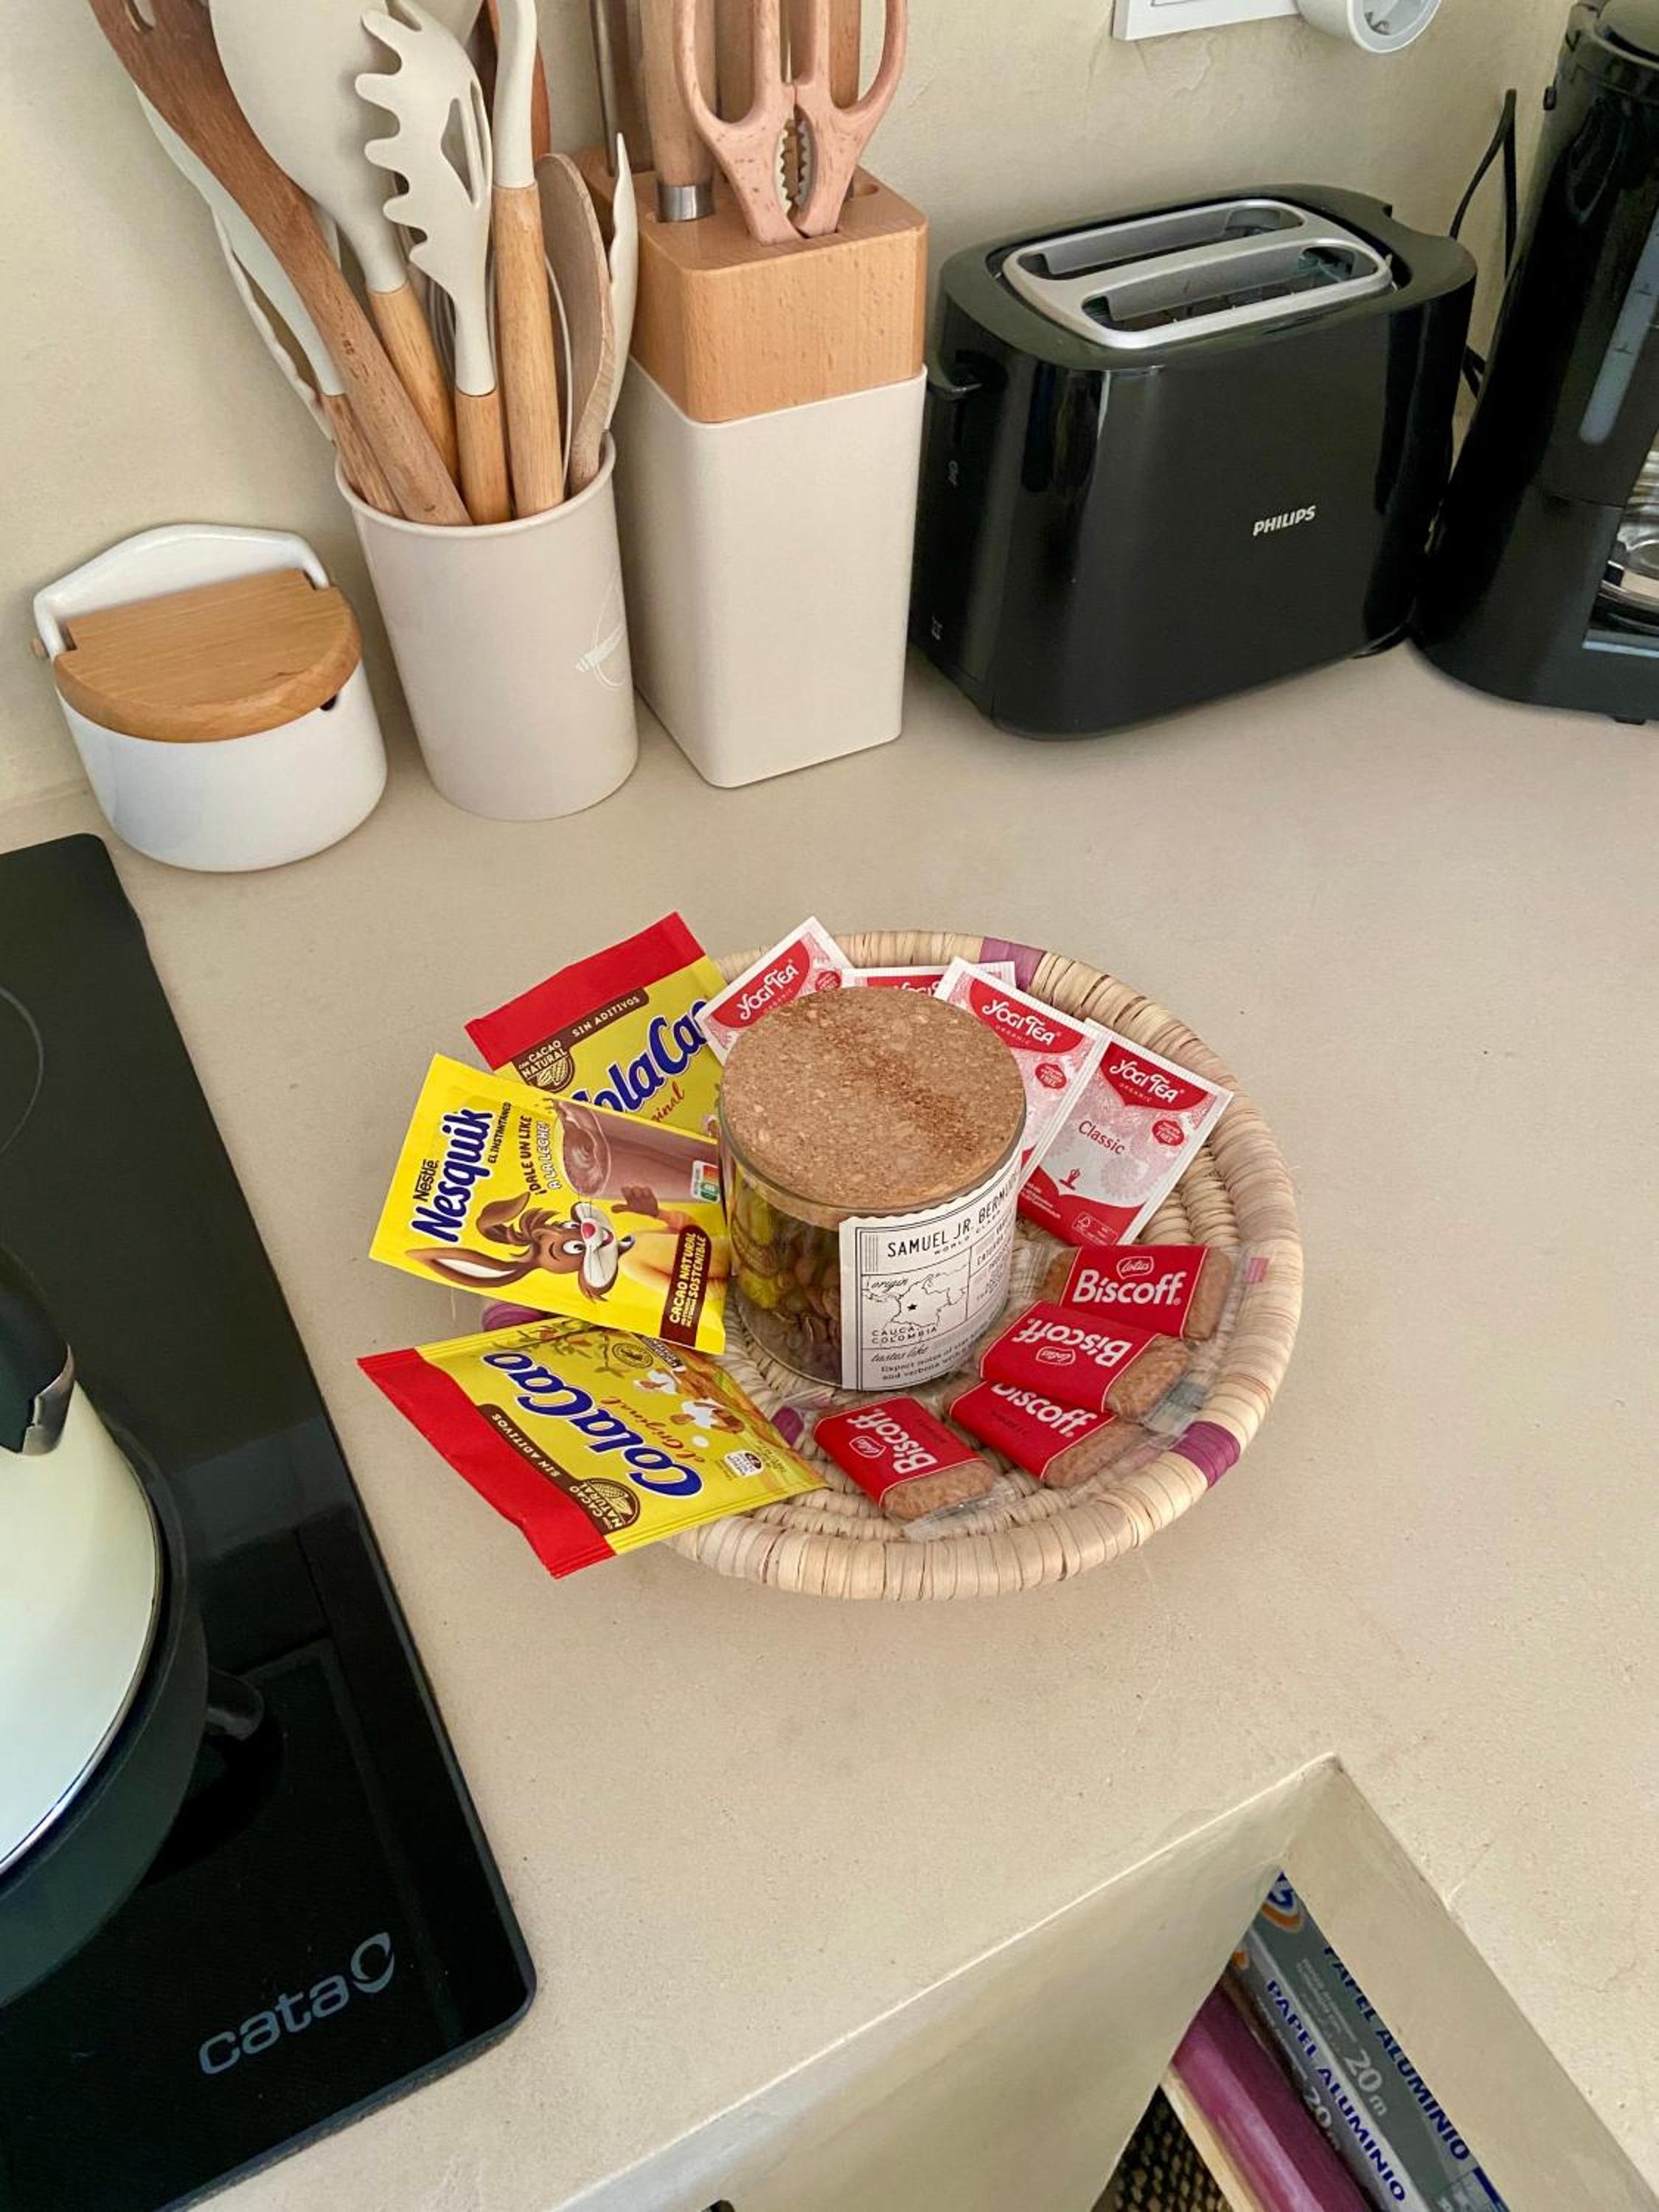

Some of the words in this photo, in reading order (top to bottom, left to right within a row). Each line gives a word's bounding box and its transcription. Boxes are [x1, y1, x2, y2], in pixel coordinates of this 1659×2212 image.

[1253, 504, 1316, 536] PHILIPS
[737, 985, 775, 1020] YOGI
[764, 964, 799, 990] TEA
[571, 1020, 593, 1037] SIN
[594, 995, 641, 1026] ADITIVOS
[981, 999, 1025, 1030] YOGI
[1025, 1015, 1057, 1046] TEA
[521, 1047, 568, 1078] NATURAL
[529, 1040, 562, 1063] CACAO
[571, 1001, 708, 1113] olaCa
[1109, 1059, 1150, 1087] YOGI
[1148, 1073, 1180, 1104] TEA
[518, 1115, 533, 1139] LIKE
[1078, 1119, 1126, 1155] Classic
[518, 1140, 532, 1160] UN
[542, 1163, 557, 1180] LA
[410, 1107, 495, 1244] Nesquik
[547, 1179, 563, 1190] A
[886, 1230, 949, 1258] SAMUEL
[955, 1217, 974, 1240] JR.
[669, 1280, 686, 1324] CACAO
[681, 1231, 697, 1281] NATURAL
[687, 1236, 707, 1299] SOSTENIBLE
[871, 1276, 908, 1293] origin
[1071, 1268, 1188, 1305] Biscoff
[1121, 1259, 1151, 1274] Lotus
[872, 1326, 937, 1344] COLOMBIA
[1012, 1318, 1133, 1368] Biscoff
[481, 1352, 704, 1498] ColaCao
[491, 1413, 539, 1465] ADITIVOS
[846, 1410, 938, 1475] Biscoff
[538, 1455, 561, 1479] SIN
[568, 1485, 603, 1518] CACAO
[581, 1481, 624, 1529] NATURAL
[198, 1973, 351, 2076] cata
[1265, 1980, 1318, 2057] PAPEL
[1317, 2067, 1406, 2202] ALUMINIO
[1344, 2048, 1383, 2093] 20
[1368, 2094, 1388, 2117] m
[1375, 2028, 1470, 2160] ALUMINIO
[1304, 2085, 1332, 2129] 20
